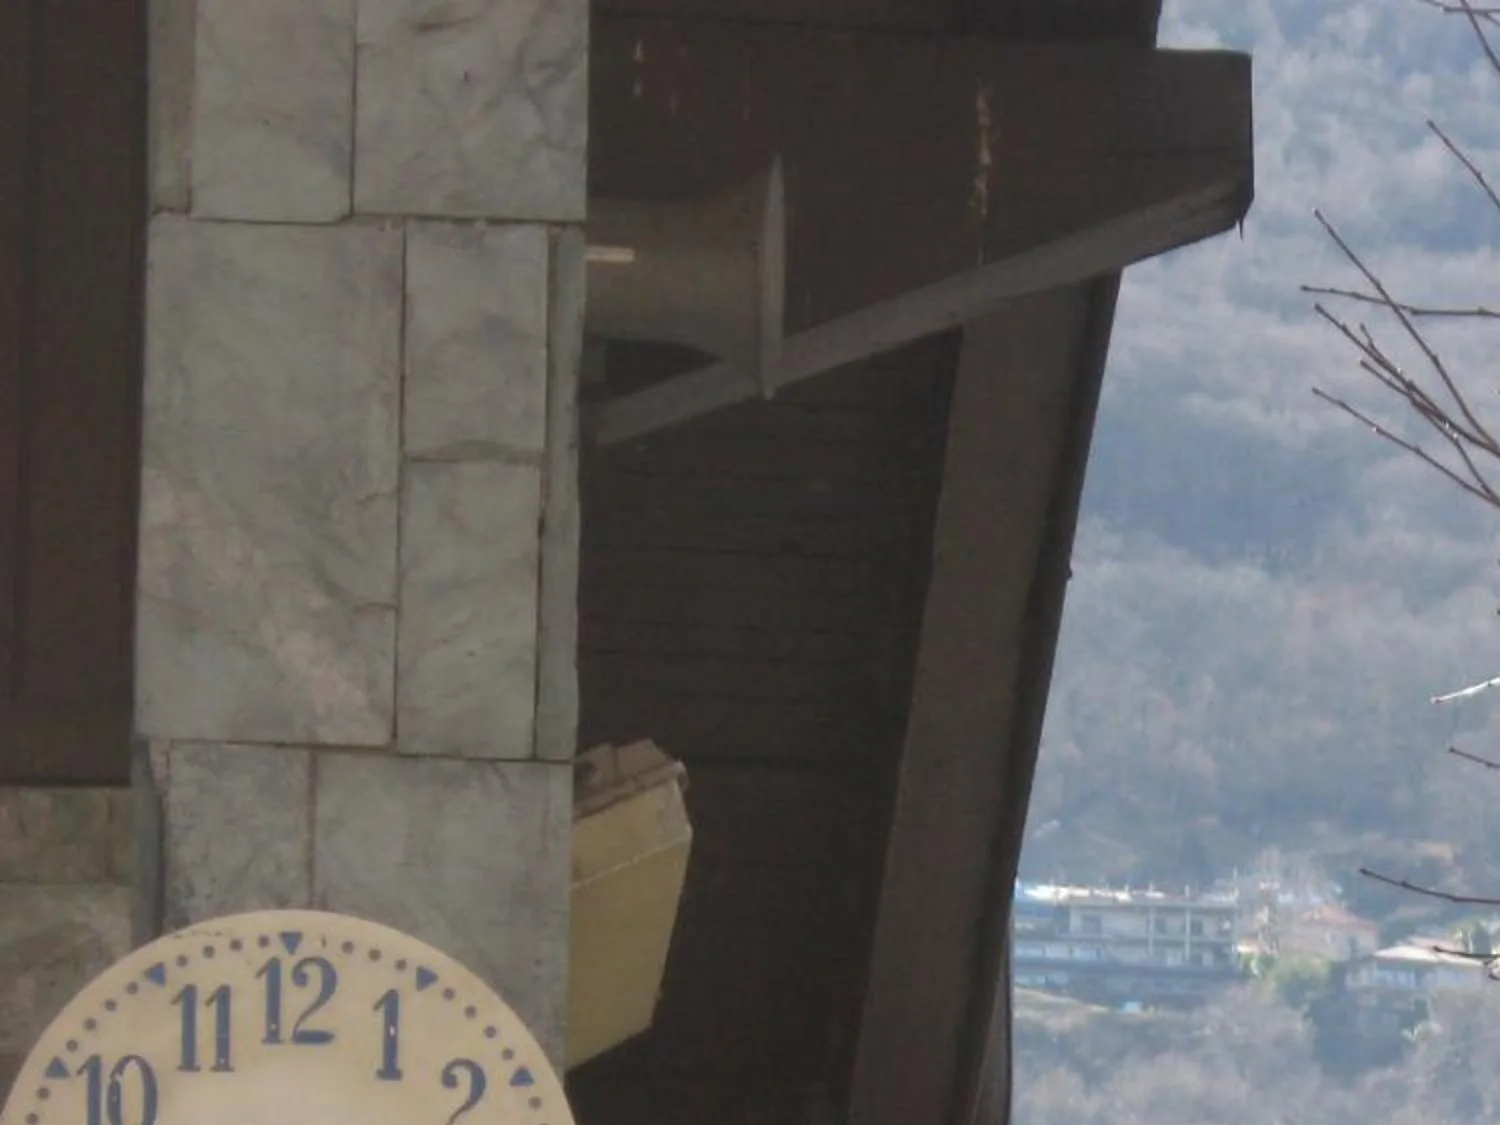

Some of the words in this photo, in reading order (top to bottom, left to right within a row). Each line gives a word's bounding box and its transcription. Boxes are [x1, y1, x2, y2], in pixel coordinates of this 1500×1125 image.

[170, 984, 235, 1072] 11
[255, 956, 338, 1045] 12
[372, 989, 402, 1080] 1
